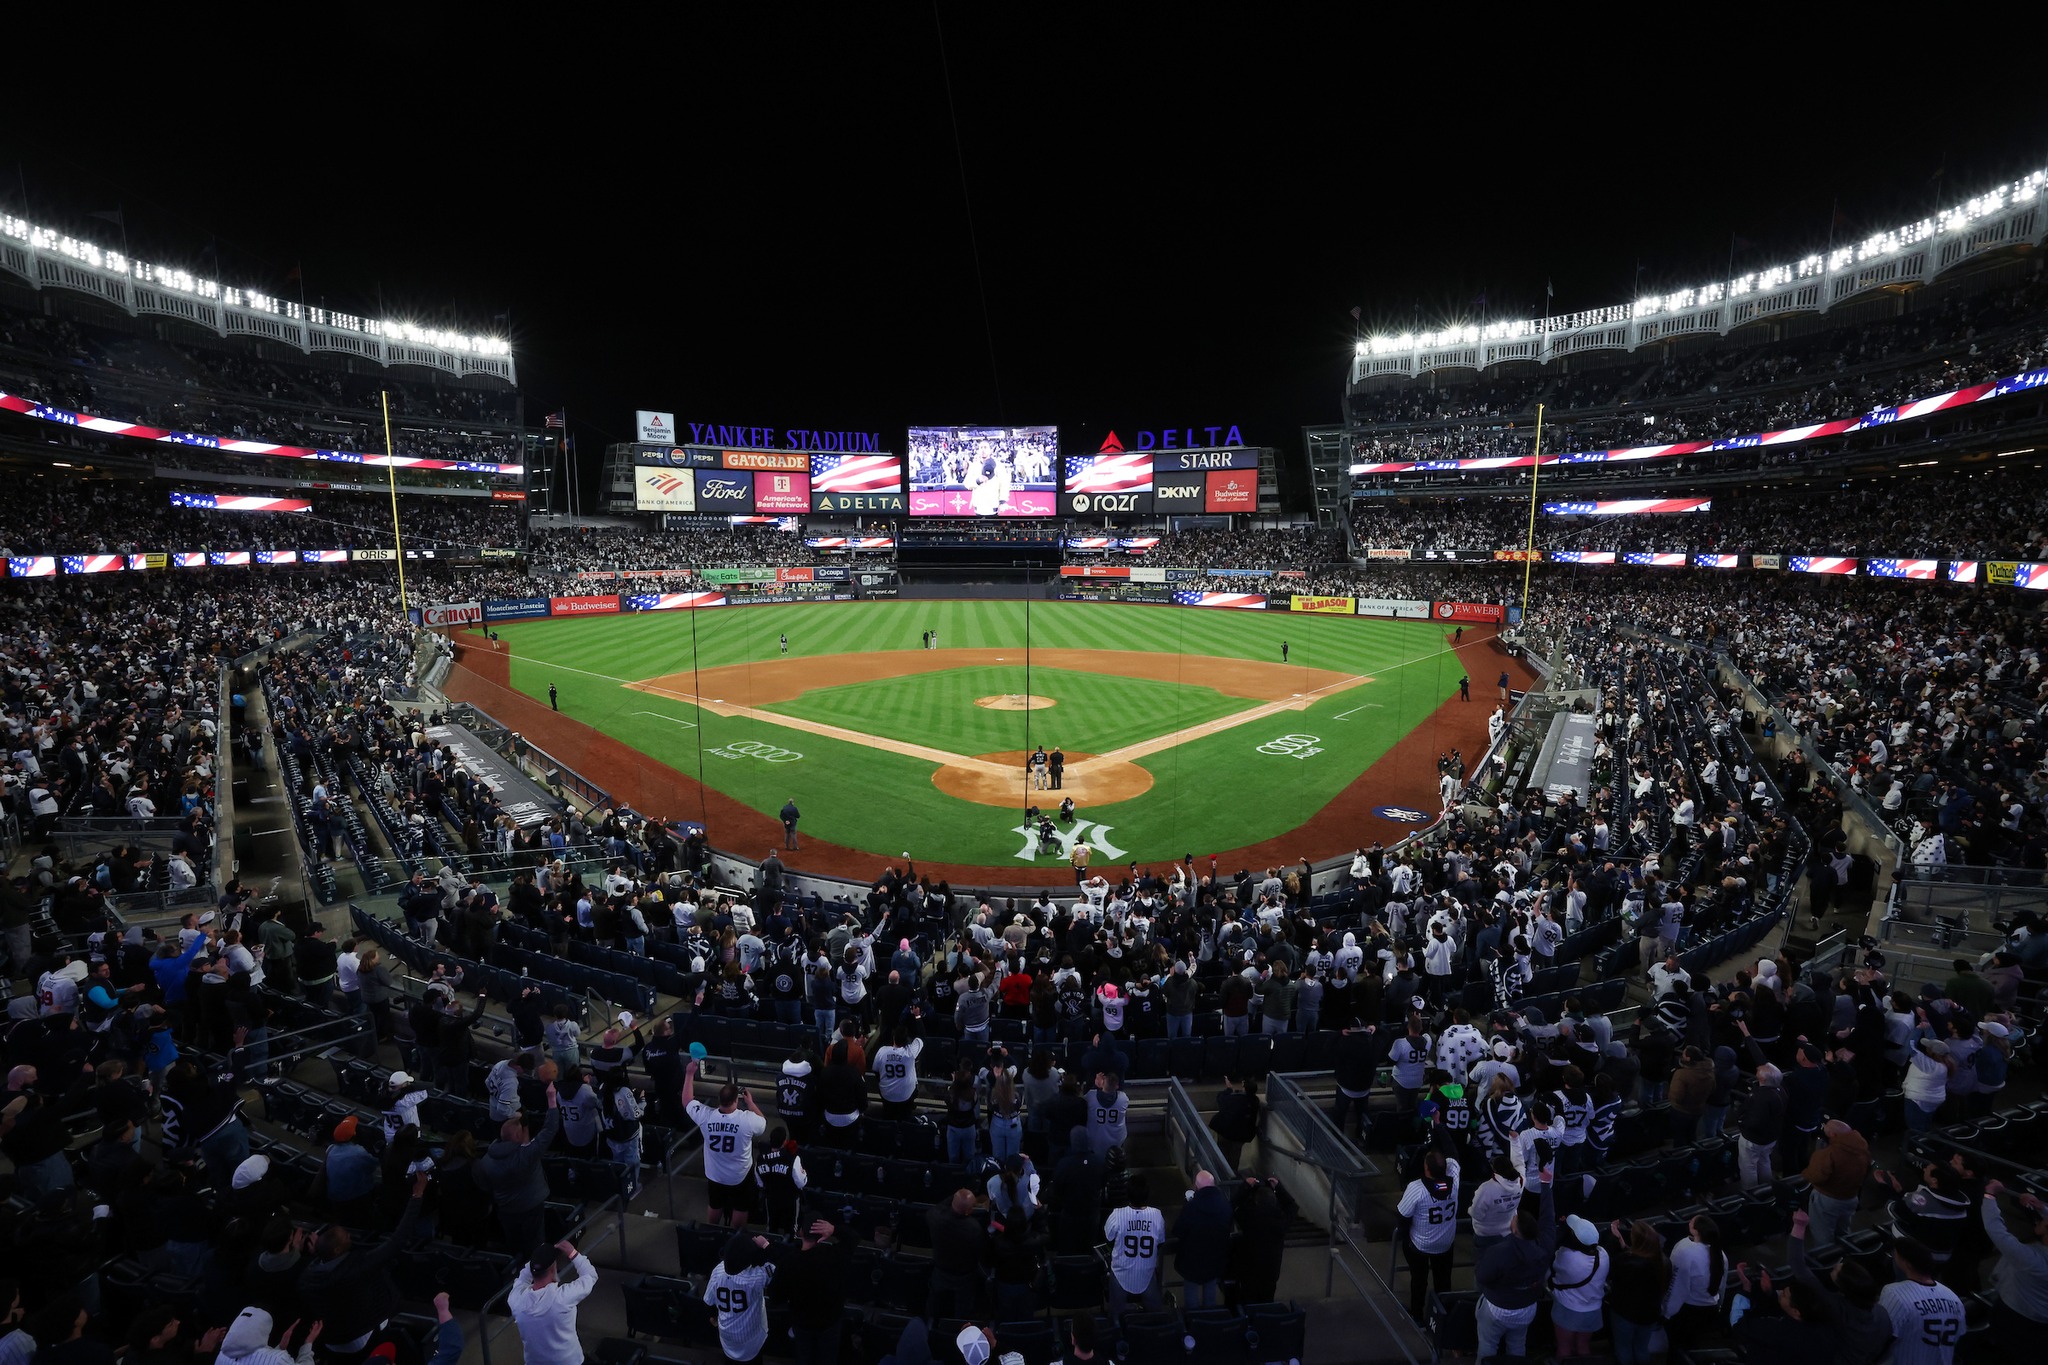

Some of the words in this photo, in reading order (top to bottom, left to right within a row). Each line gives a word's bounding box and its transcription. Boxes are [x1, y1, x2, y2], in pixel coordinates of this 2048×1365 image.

[643, 426, 671, 435] Benjamin
[647, 432, 667, 440] Moore
[688, 422, 775, 449] YANKEE
[786, 429, 880, 452] STADIUM
[1137, 425, 1244, 450] DELTA
[642, 451, 664, 459] PEPSI
[727, 454, 805, 469] GATORADE
[1180, 452, 1233, 469] STARR
[701, 479, 747, 500] Ford
[1157, 486, 1200, 498] DKNY
[1214, 490, 1249, 498] Budweiser
[840, 497, 902, 510] DELTA
[1093, 494, 1139, 511] razr
[360, 551, 388, 559] ORIS
[486, 603, 518, 612] Montefiore
[520, 602, 545, 610] Einstein
[571, 601, 617, 611] Budweiser
[1455, 605, 1471, 613] F.W.
[1473, 606, 1500, 616] WEBB
[424, 603, 481, 625] Canon
[1543, 930, 1558, 943] 99
[1346, 956, 1360, 968] 99
[936, 986, 951, 997] 99
[1409, 1050, 1428, 1063] 99
[884, 1064, 906, 1078] 99
[1449, 1098, 1468, 1108] JUDGE
[1096, 1108, 1118, 1124] 99
[1446, 1109, 1470, 1129] 99
[1565, 1111, 1587, 1128] 27
[707, 1122, 740, 1134] STOWERS
[709, 1135, 735, 1153] 28
[757, 1163, 771, 1174] NEW
[772, 1164, 789, 1175] YORK
[1428, 1201, 1456, 1224] 63
[1126, 1219, 1152, 1232] JUDGE
[1124, 1235, 1154, 1258] 99
[716, 1286, 748, 1313] 99
[1922, 1318, 1959, 1347] 52
